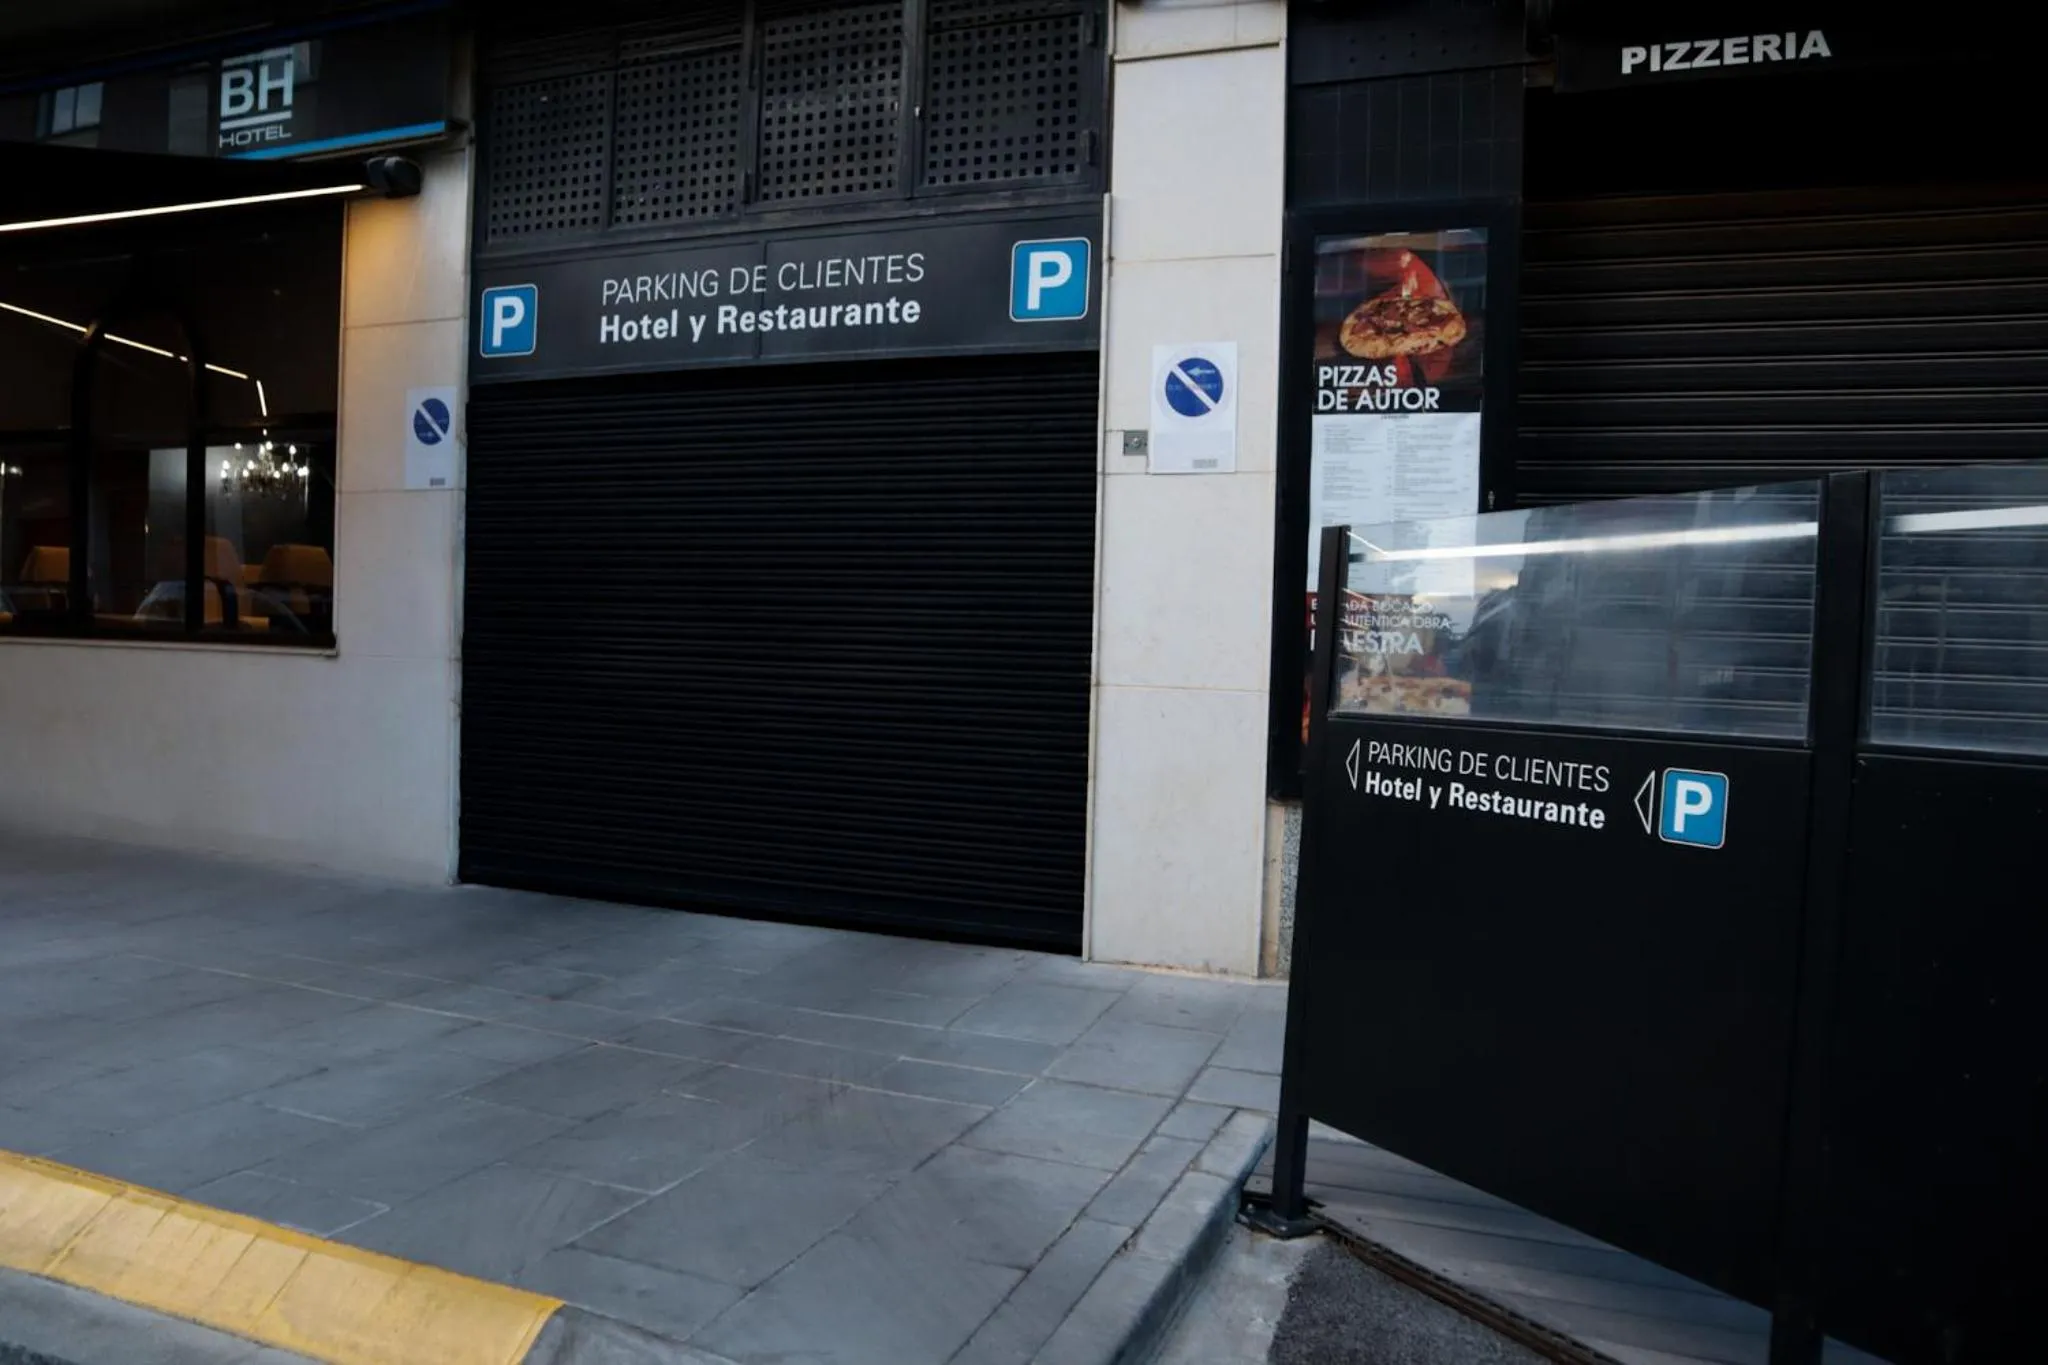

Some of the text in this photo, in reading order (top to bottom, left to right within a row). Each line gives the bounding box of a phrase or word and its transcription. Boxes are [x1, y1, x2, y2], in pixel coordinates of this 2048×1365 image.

[1621, 29, 1834, 76] PIZZERIA
[220, 59, 295, 118] BH
[219, 124, 292, 148] HOTEL
[602, 252, 926, 305] PARKING DE CLIENTES
[1026, 251, 1072, 312] P
[491, 296, 526, 348] P
[599, 295, 922, 344] Hotel y Restaurante
[1318, 365, 1398, 388] PIZZAS
[1318, 388, 1441, 411] DE AUTOR
[1415, 615, 1453, 631] OBRA
[1366, 740, 1612, 794] PARKING DE CLIENTES
[1364, 771, 1607, 830] Hotel y Restaurante
[1672, 779, 1713, 832] P
